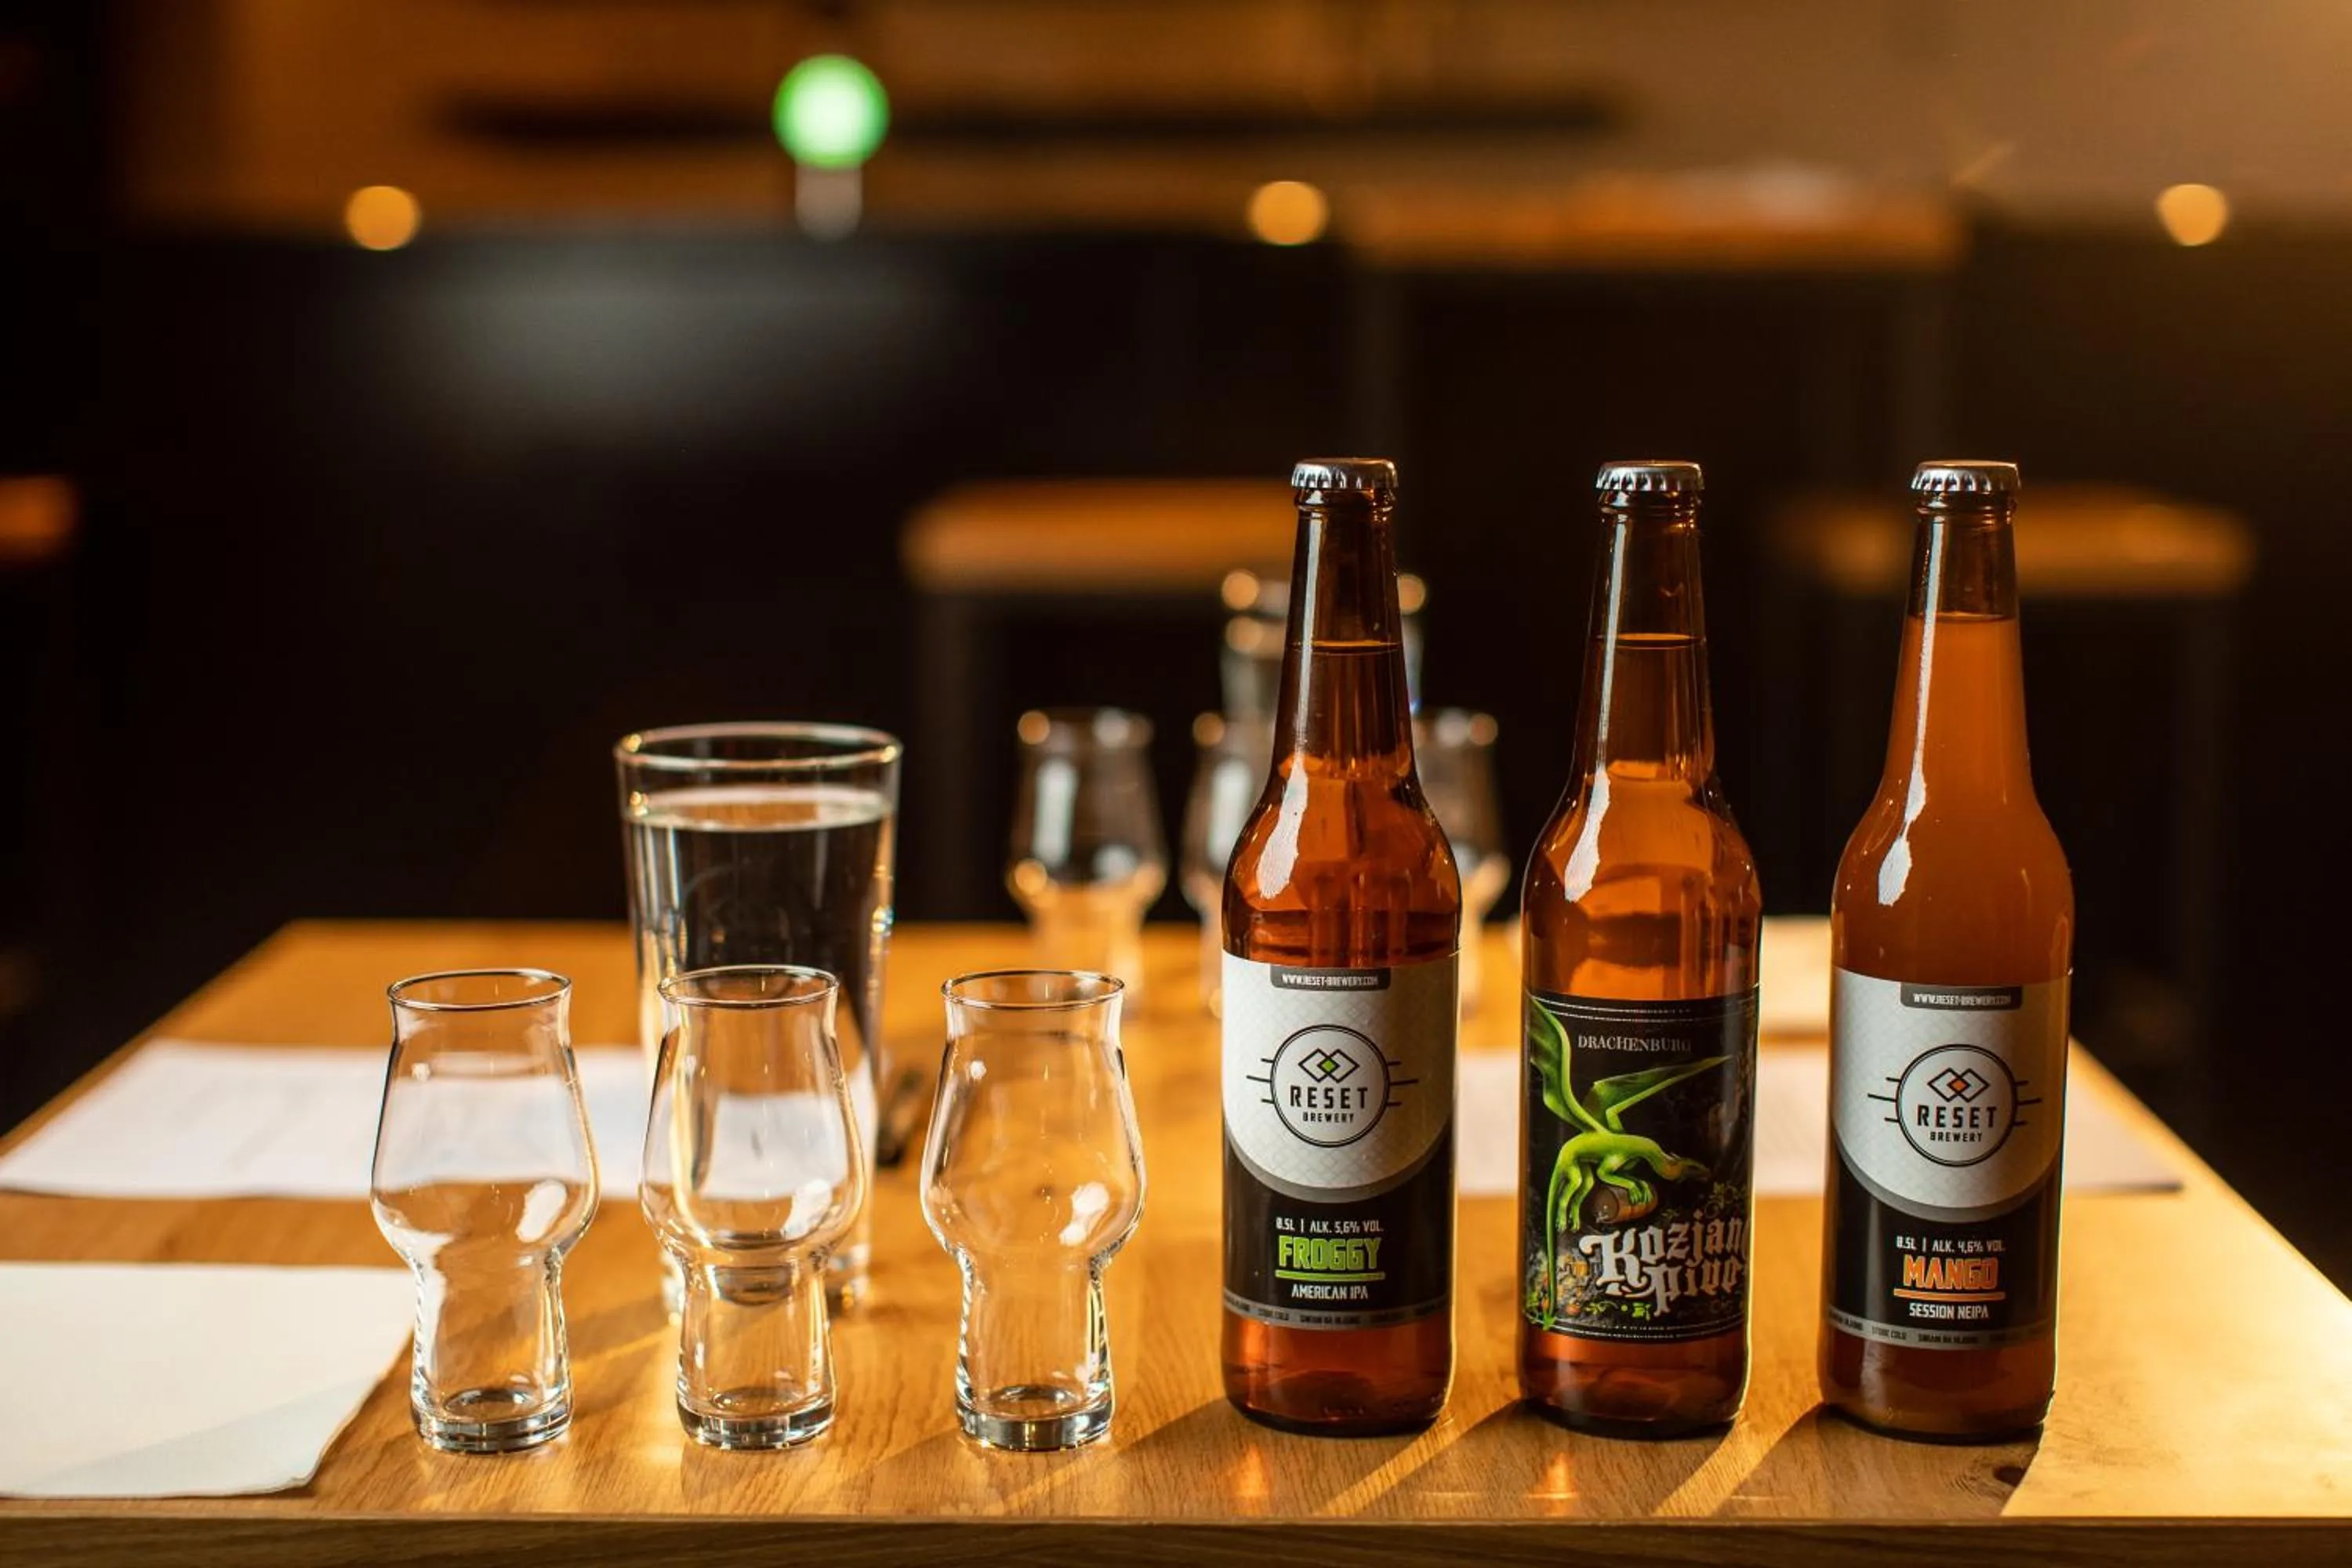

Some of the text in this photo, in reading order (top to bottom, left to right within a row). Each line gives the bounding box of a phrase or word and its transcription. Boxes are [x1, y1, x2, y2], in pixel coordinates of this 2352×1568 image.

[1577, 1034, 1692, 1052] DRACHENBURG
[1290, 1085, 1368, 1109] RESET
[1302, 1112, 1355, 1123] BREWERY
[1917, 1105, 1998, 1128] RESET
[1929, 1131, 1983, 1142] BREWERY
[1309, 1220, 1332, 1234] ALK.
[1334, 1220, 1360, 1234] 5,6%
[1362, 1220, 1384, 1232] VOL.
[1278, 1235, 1382, 1271] FROGGY
[1932, 1240, 1955, 1253] ALK.
[1986, 1240, 2005, 1252] VOL.
[1903, 1254, 1998, 1290] MANGO
[1291, 1283, 1368, 1300] AMERICAN IPA
[1909, 1302, 1989, 1319] SESSION NEIPA
